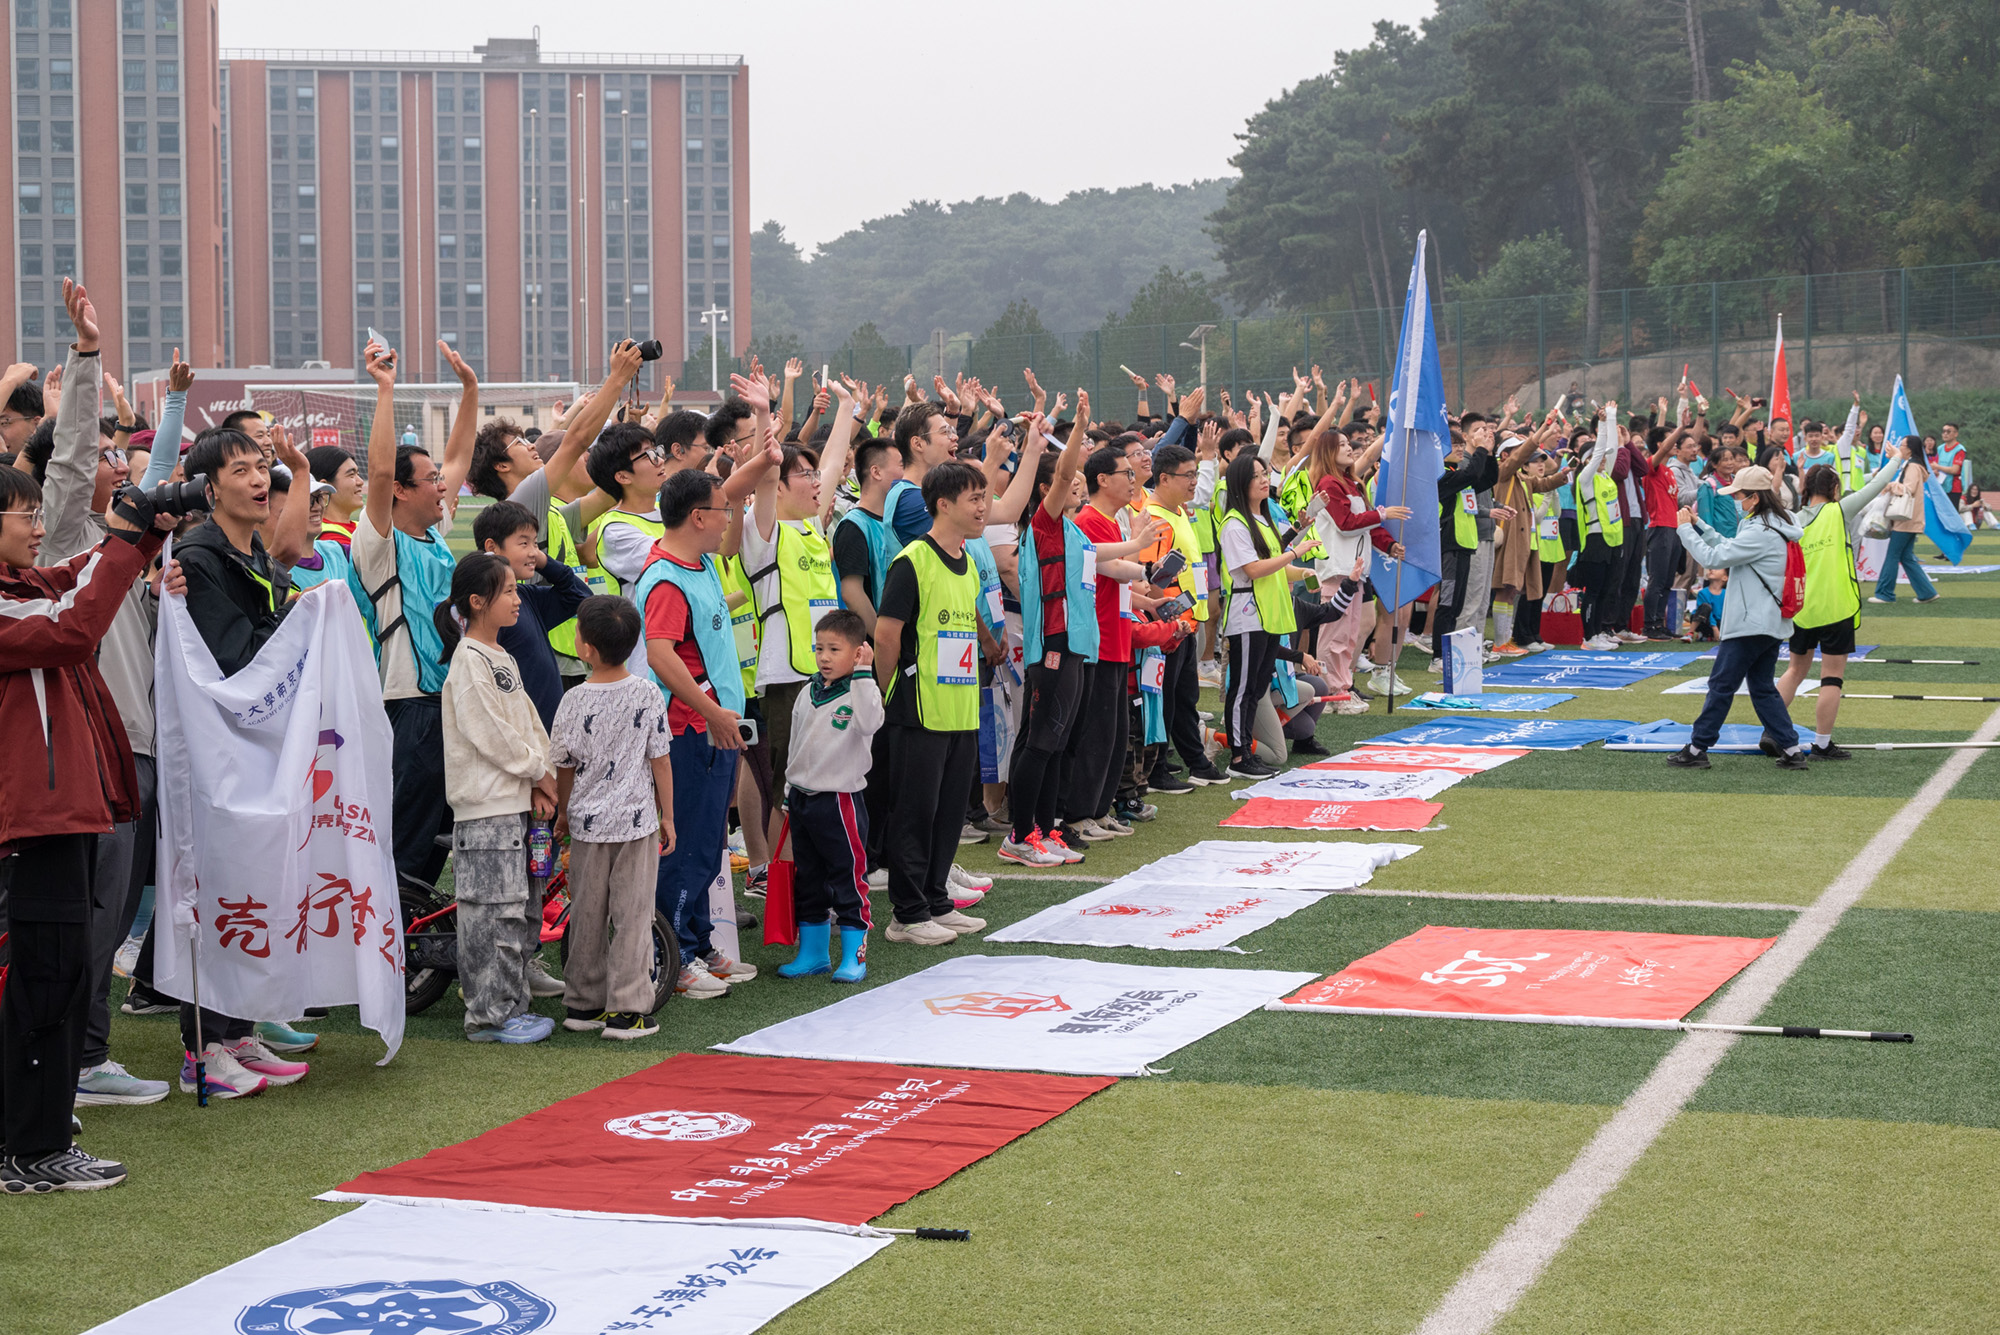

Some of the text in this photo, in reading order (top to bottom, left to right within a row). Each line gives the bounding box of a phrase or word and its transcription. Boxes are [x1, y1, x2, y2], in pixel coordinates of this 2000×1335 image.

[1465, 493, 1475, 510] 5
[1551, 520, 1559, 536] 3
[958, 642, 973, 674] 4
[1155, 662, 1165, 687] 8
[709, 906, 724, 916] 大学
[600, 1247, 780, 1335] 学天津校友会
